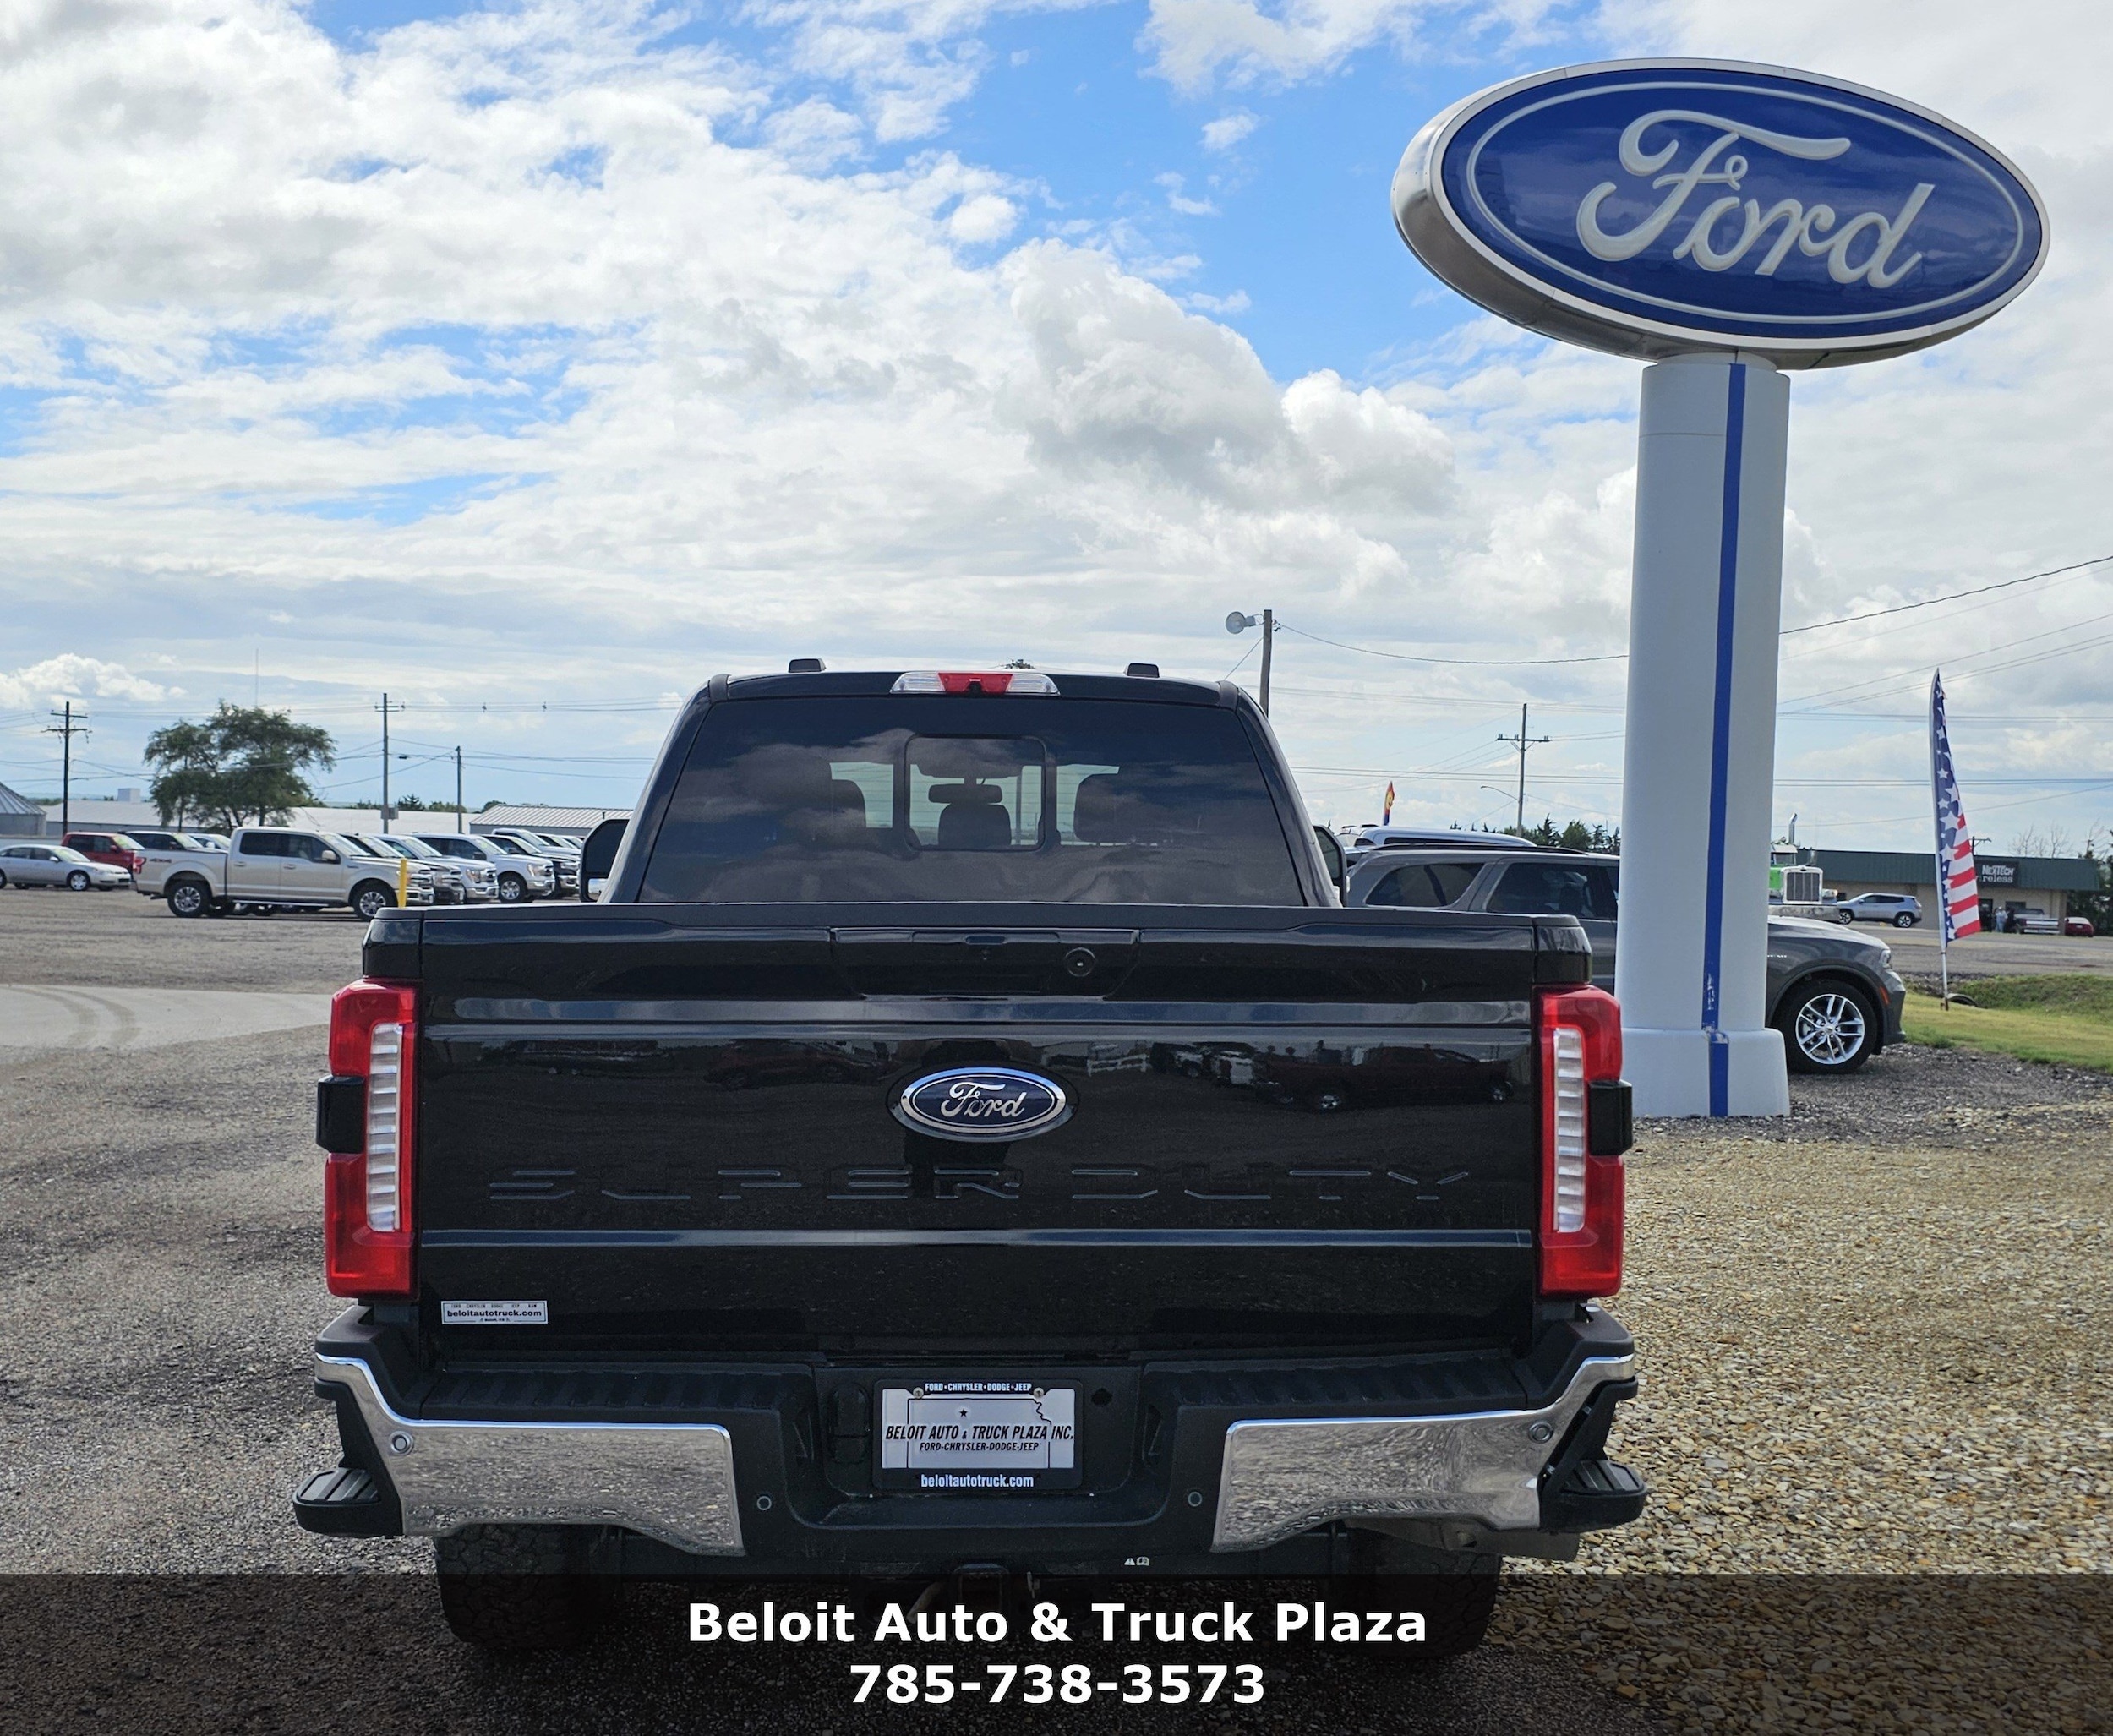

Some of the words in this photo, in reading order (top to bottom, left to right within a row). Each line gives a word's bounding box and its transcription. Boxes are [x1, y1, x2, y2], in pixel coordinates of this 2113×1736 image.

[1576, 109, 1935, 289] Ford
[940, 1081, 1028, 1118] Ford
[489, 1168, 1020, 1200] SUPER
[886, 1425, 926, 1440] BELOIT
[928, 1425, 959, 1440] AUTO
[962, 1430, 968, 1439] &
[972, 1425, 1010, 1440] TRUCK
[1012, 1425, 1047, 1440] PLAZA
[1051, 1425, 1074, 1440] INC.
[919, 1442, 1040, 1451] FORD-CHRYSLER-DODGE-JEEP
[920, 1474, 1034, 1488] beloitautotruck.com
